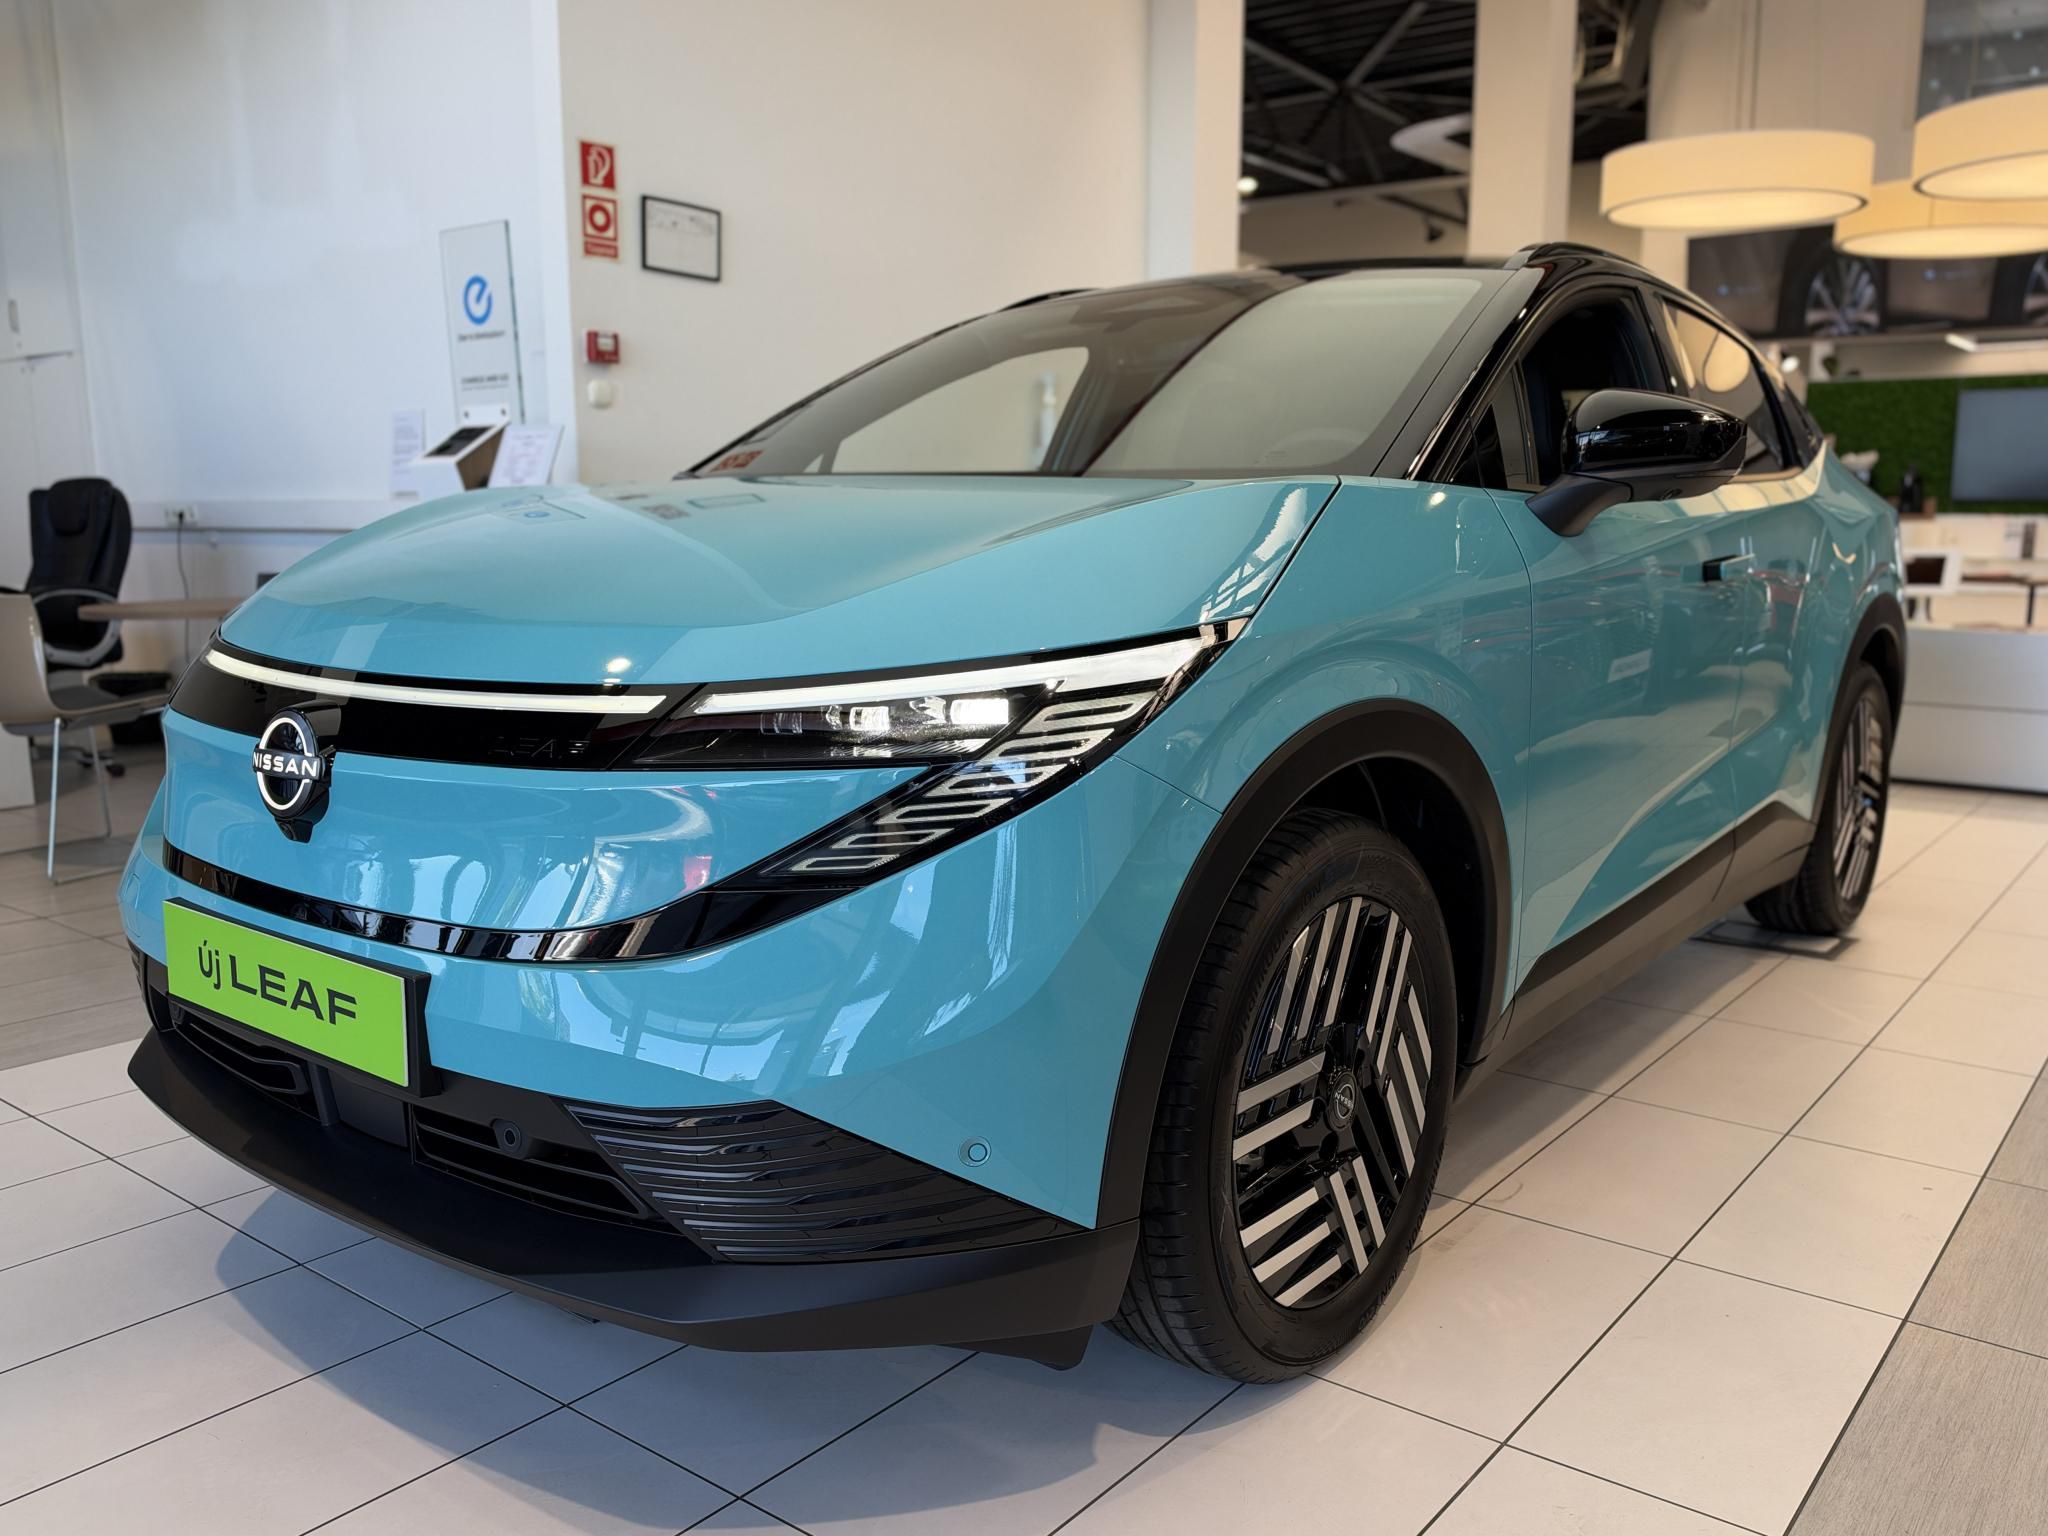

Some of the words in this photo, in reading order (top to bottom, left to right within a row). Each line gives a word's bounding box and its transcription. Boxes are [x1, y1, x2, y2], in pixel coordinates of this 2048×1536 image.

[252, 751, 318, 777] NISSAN
[198, 939, 221, 990] Új
[230, 954, 358, 1026] LEAF
